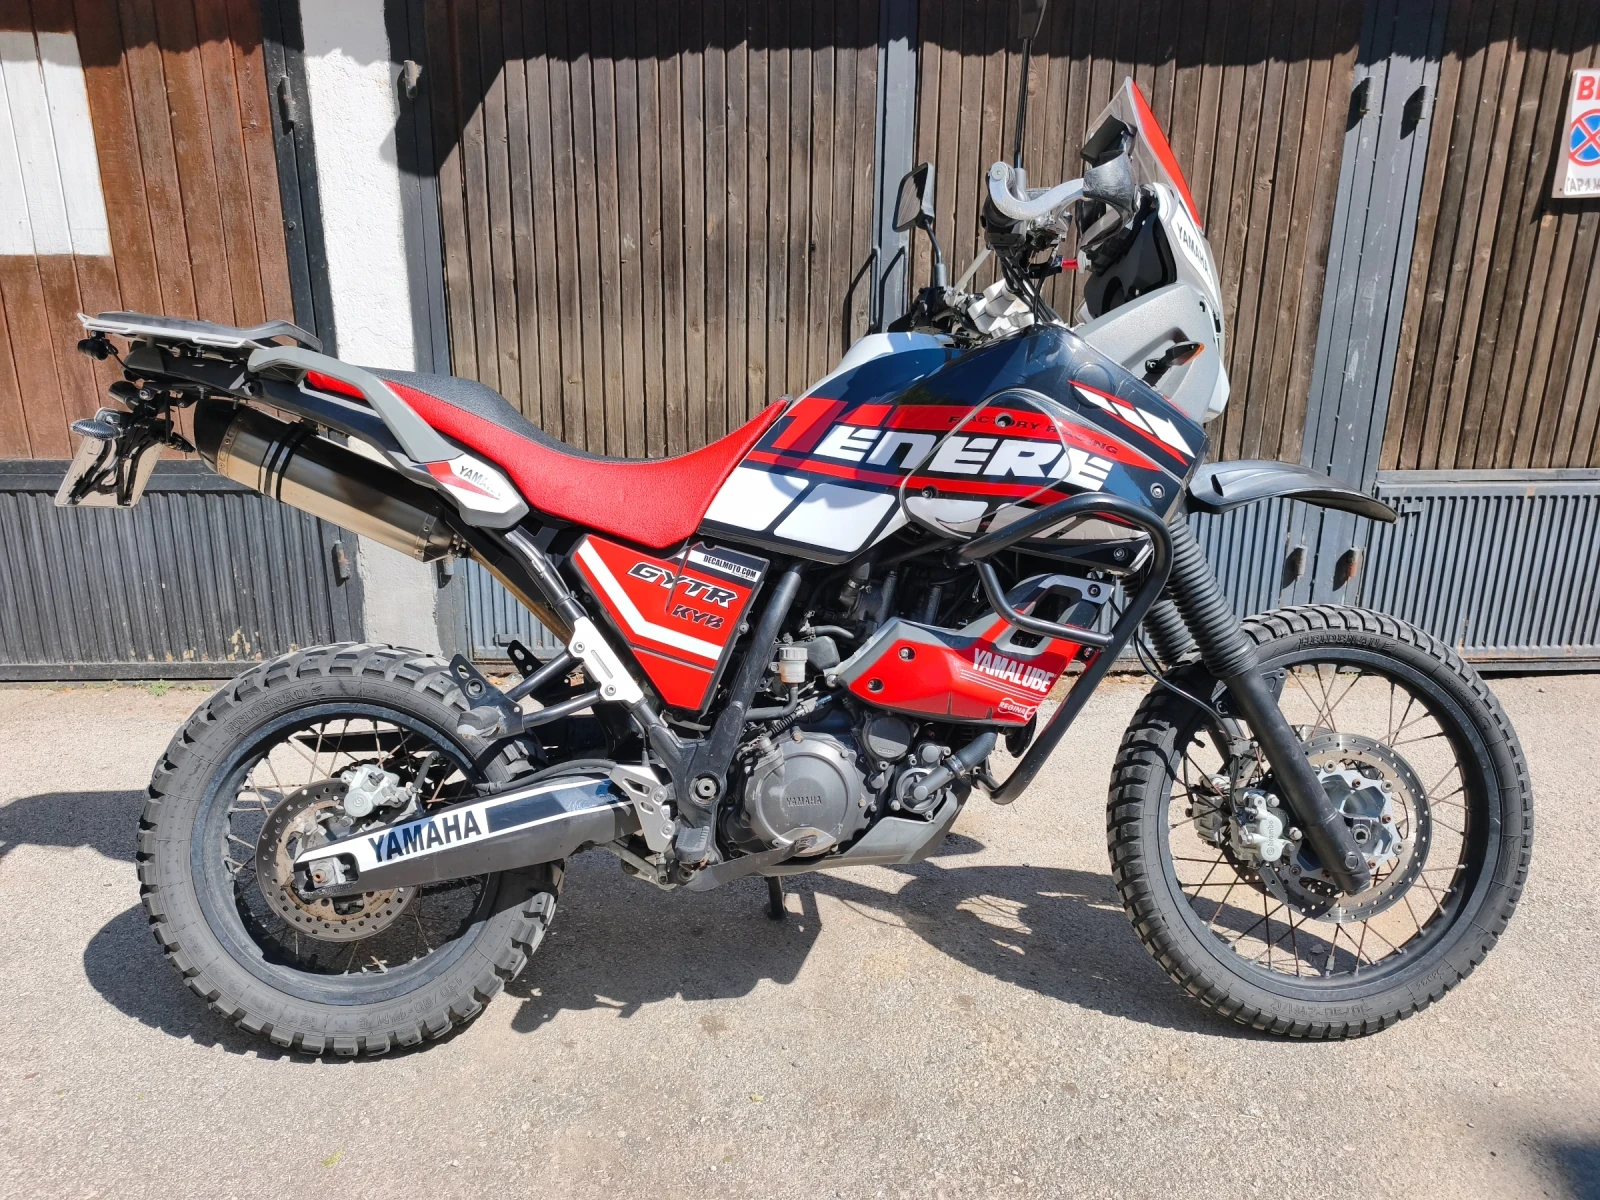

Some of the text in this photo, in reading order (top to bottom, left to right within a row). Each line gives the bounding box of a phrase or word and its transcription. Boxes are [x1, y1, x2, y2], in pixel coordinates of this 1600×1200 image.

[948, 415, 1040, 430] FACRY
[703, 554, 757, 578] DECALMOTO.COM
[627, 561, 738, 609] GYTR
[671, 604, 724, 629] KYB
[973, 648, 1055, 692] YAMALUBE
[999, 701, 1026, 715] REGINA
[786, 795, 822, 807] YAMAHA
[368, 810, 482, 863] YAMAHA
